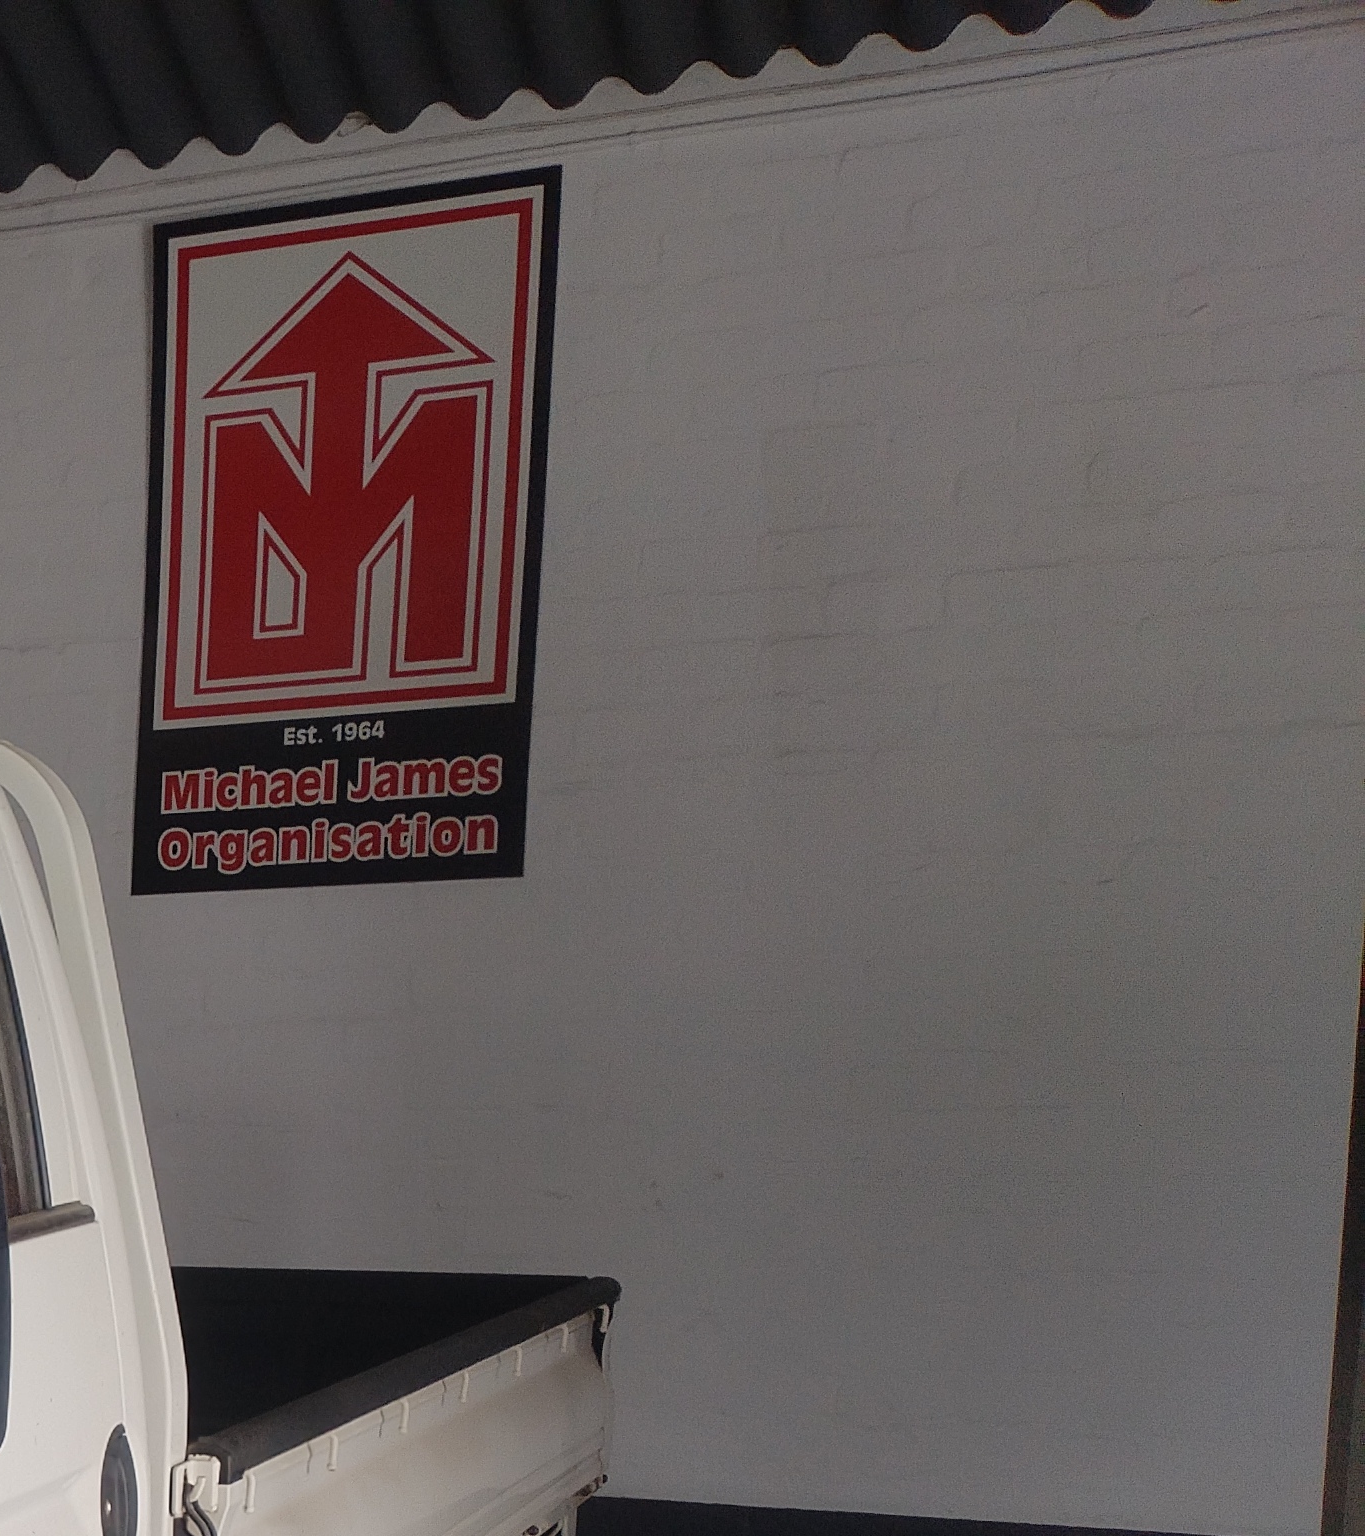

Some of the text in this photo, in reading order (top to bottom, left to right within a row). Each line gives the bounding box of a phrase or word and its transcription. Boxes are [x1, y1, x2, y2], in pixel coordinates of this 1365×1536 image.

[283, 719, 386, 746] Est. 1964
[160, 753, 503, 814] Michael James
[157, 812, 500, 874] Organisation
